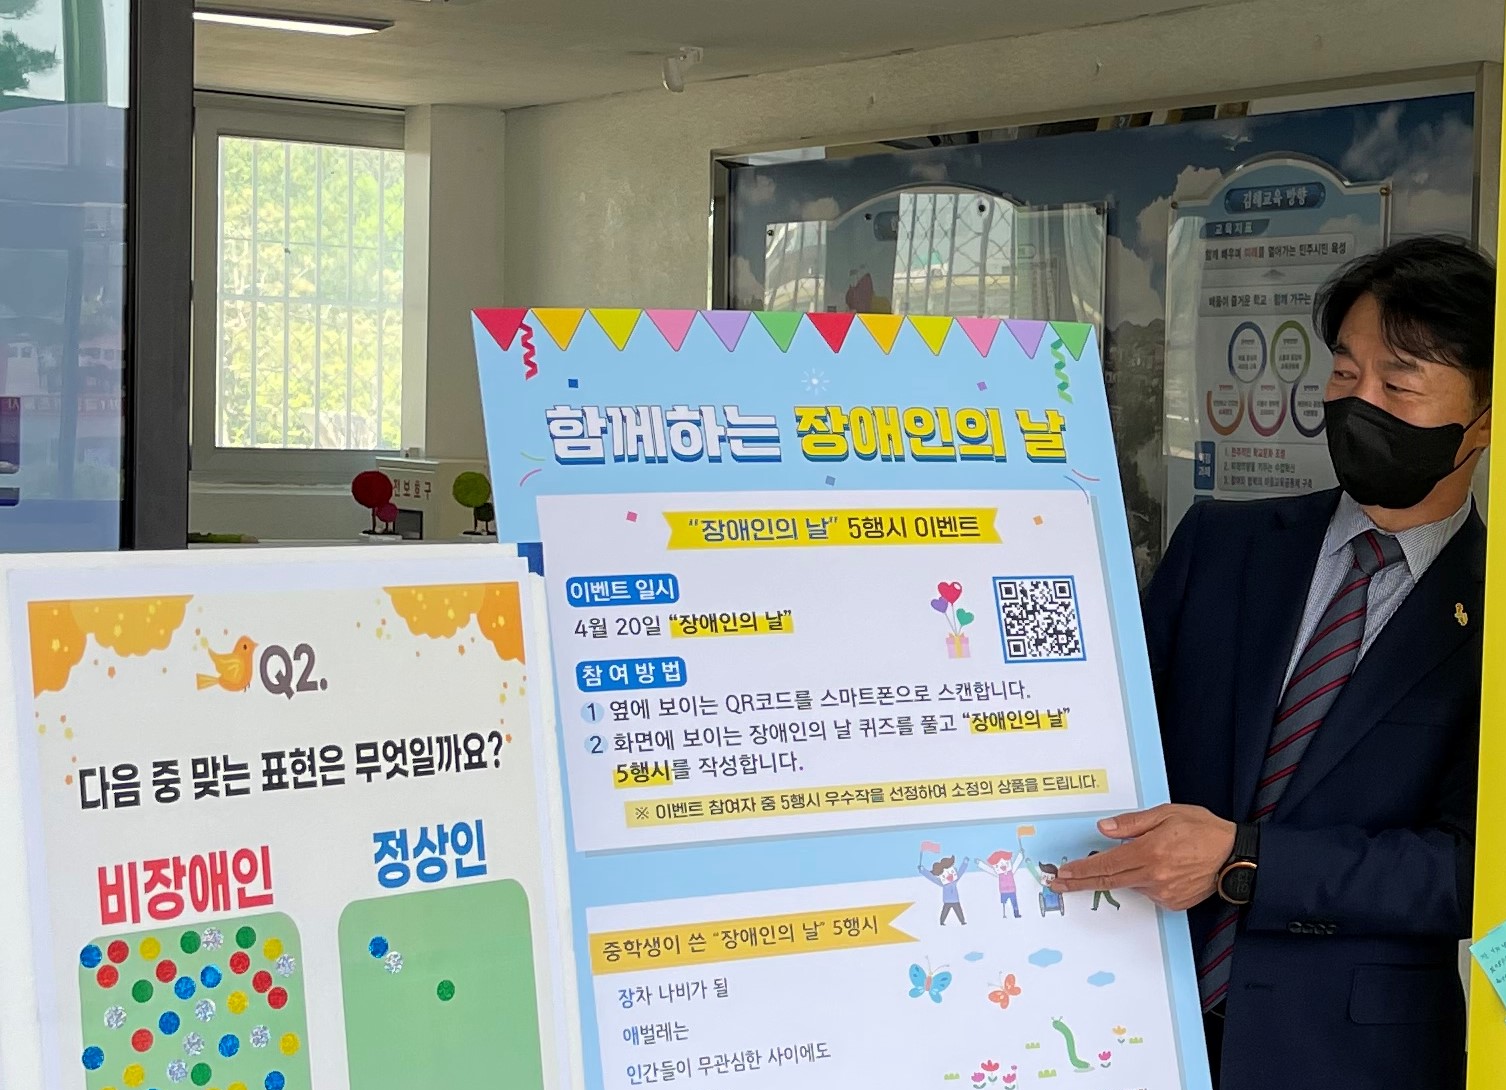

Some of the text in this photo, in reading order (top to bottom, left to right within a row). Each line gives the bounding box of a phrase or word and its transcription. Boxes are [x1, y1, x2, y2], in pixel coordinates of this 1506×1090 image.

[545, 404, 1069, 465] 함께하는 장애인의 날
[849, 516, 907, 539] 5행시
[915, 515, 980, 538] 이벤트
[570, 578, 675, 603] 이벤트 일시
[575, 618, 608, 638] 4월
[616, 615, 662, 636] 20일
[260, 642, 328, 700] Q2.
[587, 680, 1031, 721] 1 옆에 보이는 QR코드를 스마트폰으로 스캔합니다.
[591, 736, 603, 754] 2
[614, 730, 675, 753] 화면에
[683, 727, 742, 747] 보이는
[750, 721, 827, 745] 장애인의
[834, 719, 852, 740] 날
[859, 716, 914, 737] 퀴즈를
[921, 713, 957, 734] 풀고
[78, 731, 503, 809] 다음 중 맞는 표현은 무엇일까요?
[616, 751, 804, 783] 5행시를 작성합니다.
[656, 801, 703, 819] 이벤트
[709, 797, 756, 815] 참여자
[761, 796, 775, 811] 중
[781, 792, 820, 809] 5행시
[825, 788, 885, 805] 우수작을
[890, 783, 947, 802] 선정하여
[952, 781, 993, 797] 소정의
[998, 778, 1039, 794] 상품을
[1043, 774, 1100, 791] 드립니다.
[372, 819, 487, 888] 정상인
[97, 845, 274, 926] 비장애인
[603, 935, 680, 962] 중학생이
[688, 933, 707, 952] 쓴
[833, 915, 878, 936] 5행시
[618, 978, 729, 1008] 장차 나비가 될
[623, 1022, 689, 1046] 애벌레는
[627, 1042, 831, 1085] 인간들이 무관심한 사이에도
